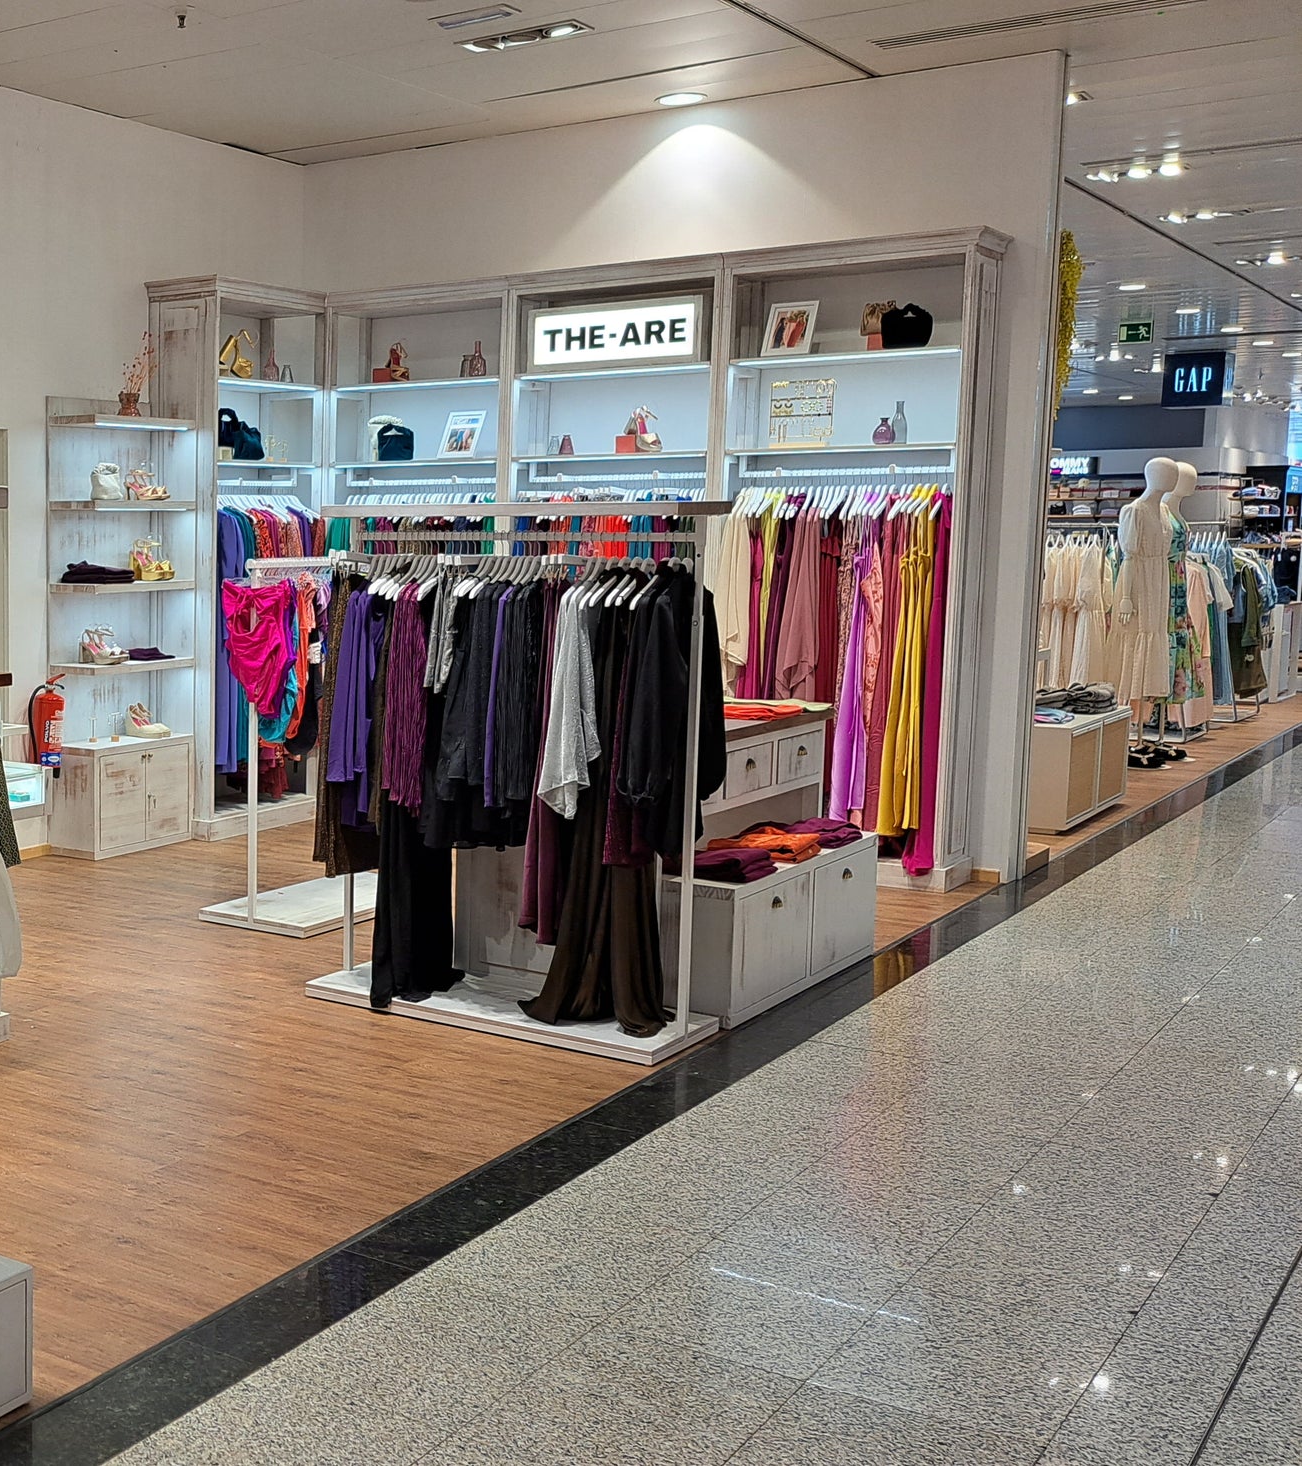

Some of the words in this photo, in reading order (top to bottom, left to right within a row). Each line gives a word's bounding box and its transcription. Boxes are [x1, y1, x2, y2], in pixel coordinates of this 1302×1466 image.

[543, 318, 687, 352] THE-ARE
[1174, 366, 1212, 393] GAP
[1050, 457, 1090, 469] OMMY
